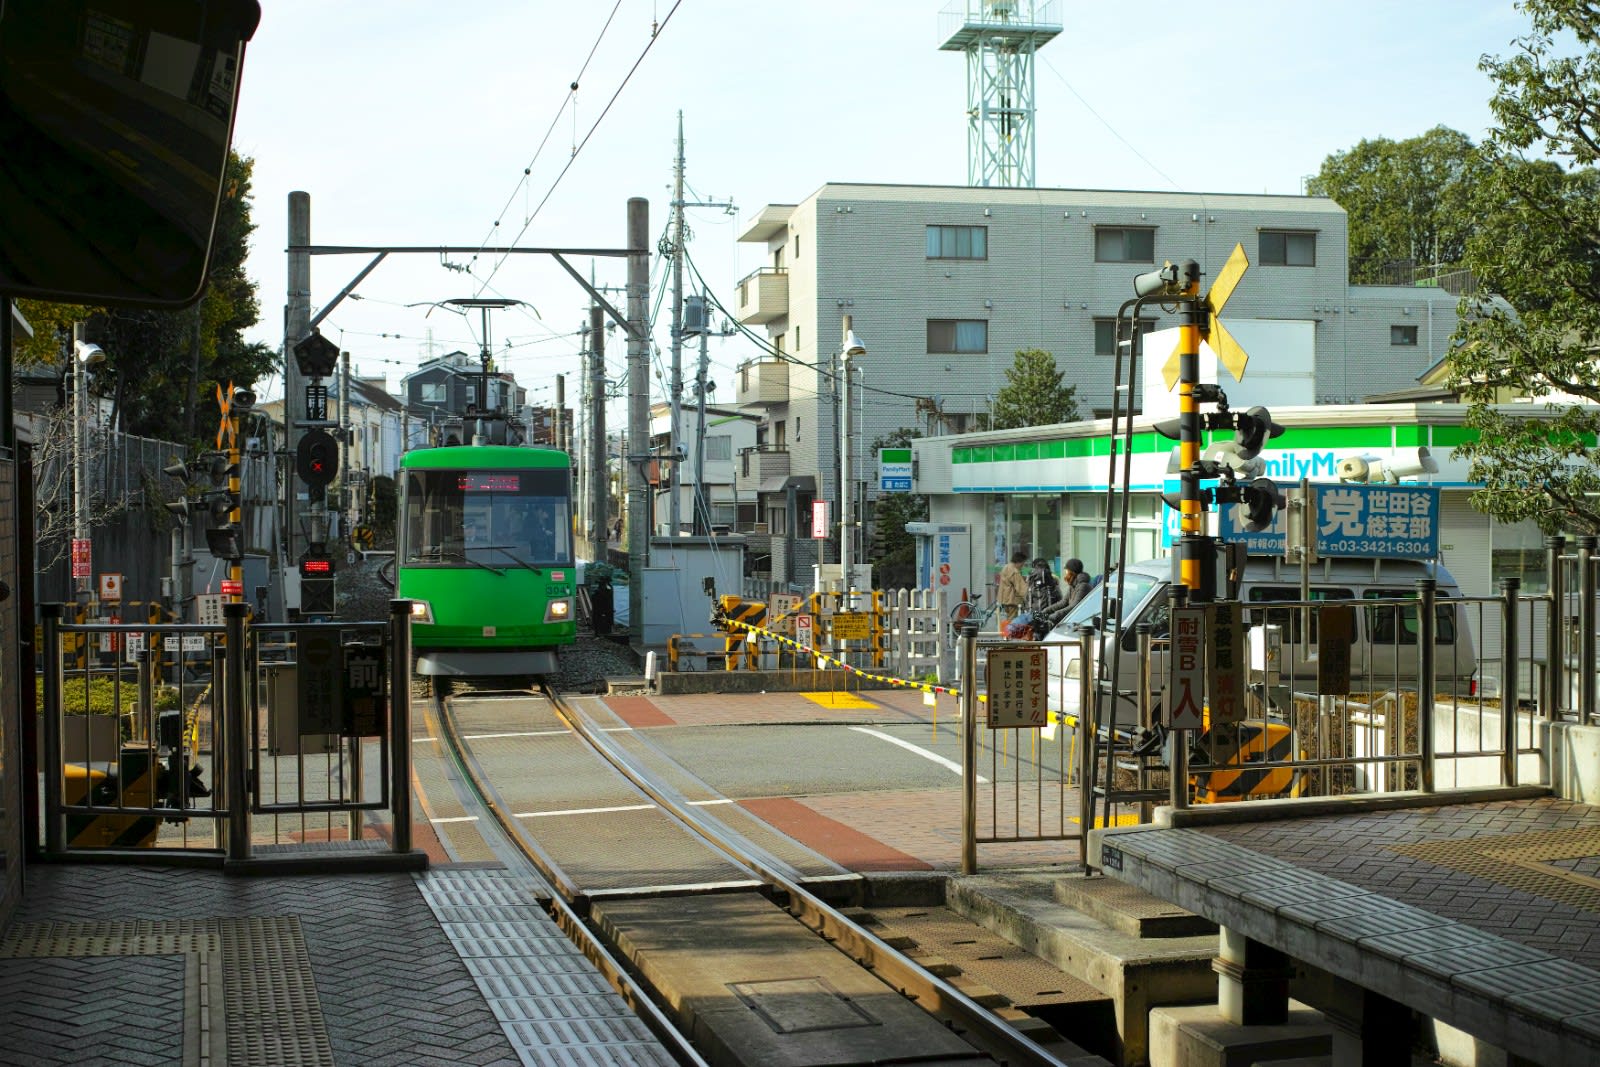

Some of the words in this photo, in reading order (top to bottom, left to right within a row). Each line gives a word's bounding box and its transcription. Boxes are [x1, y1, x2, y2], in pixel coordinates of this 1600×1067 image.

[1368, 490, 1431, 515] 世田谷
[1367, 515, 1430, 539] 総支部
[1338, 540, 1431, 553] 03-3421-6304
[1003, 660, 1011, 709] 禁止します
